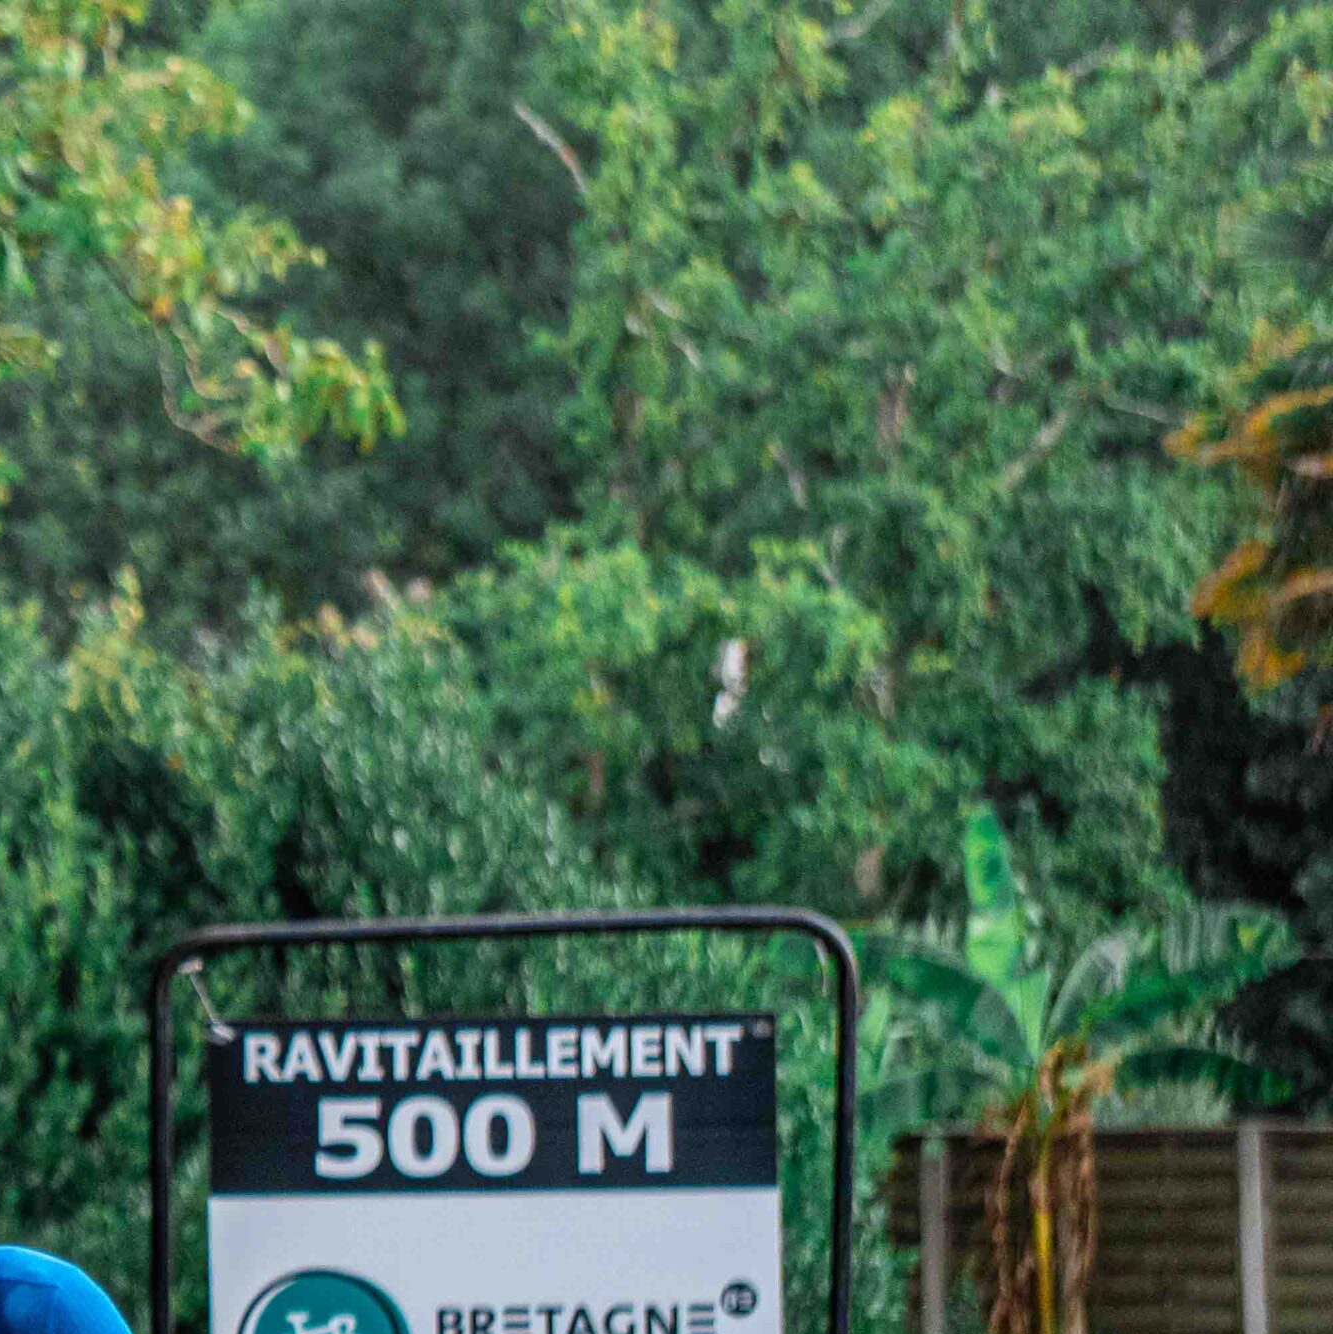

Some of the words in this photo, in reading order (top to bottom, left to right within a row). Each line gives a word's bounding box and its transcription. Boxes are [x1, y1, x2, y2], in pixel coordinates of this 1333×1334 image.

[241, 1024, 743, 1084] RAVITAILLEMENT
[314, 1095, 537, 1179] 500
[576, 1092, 674, 1176] M
